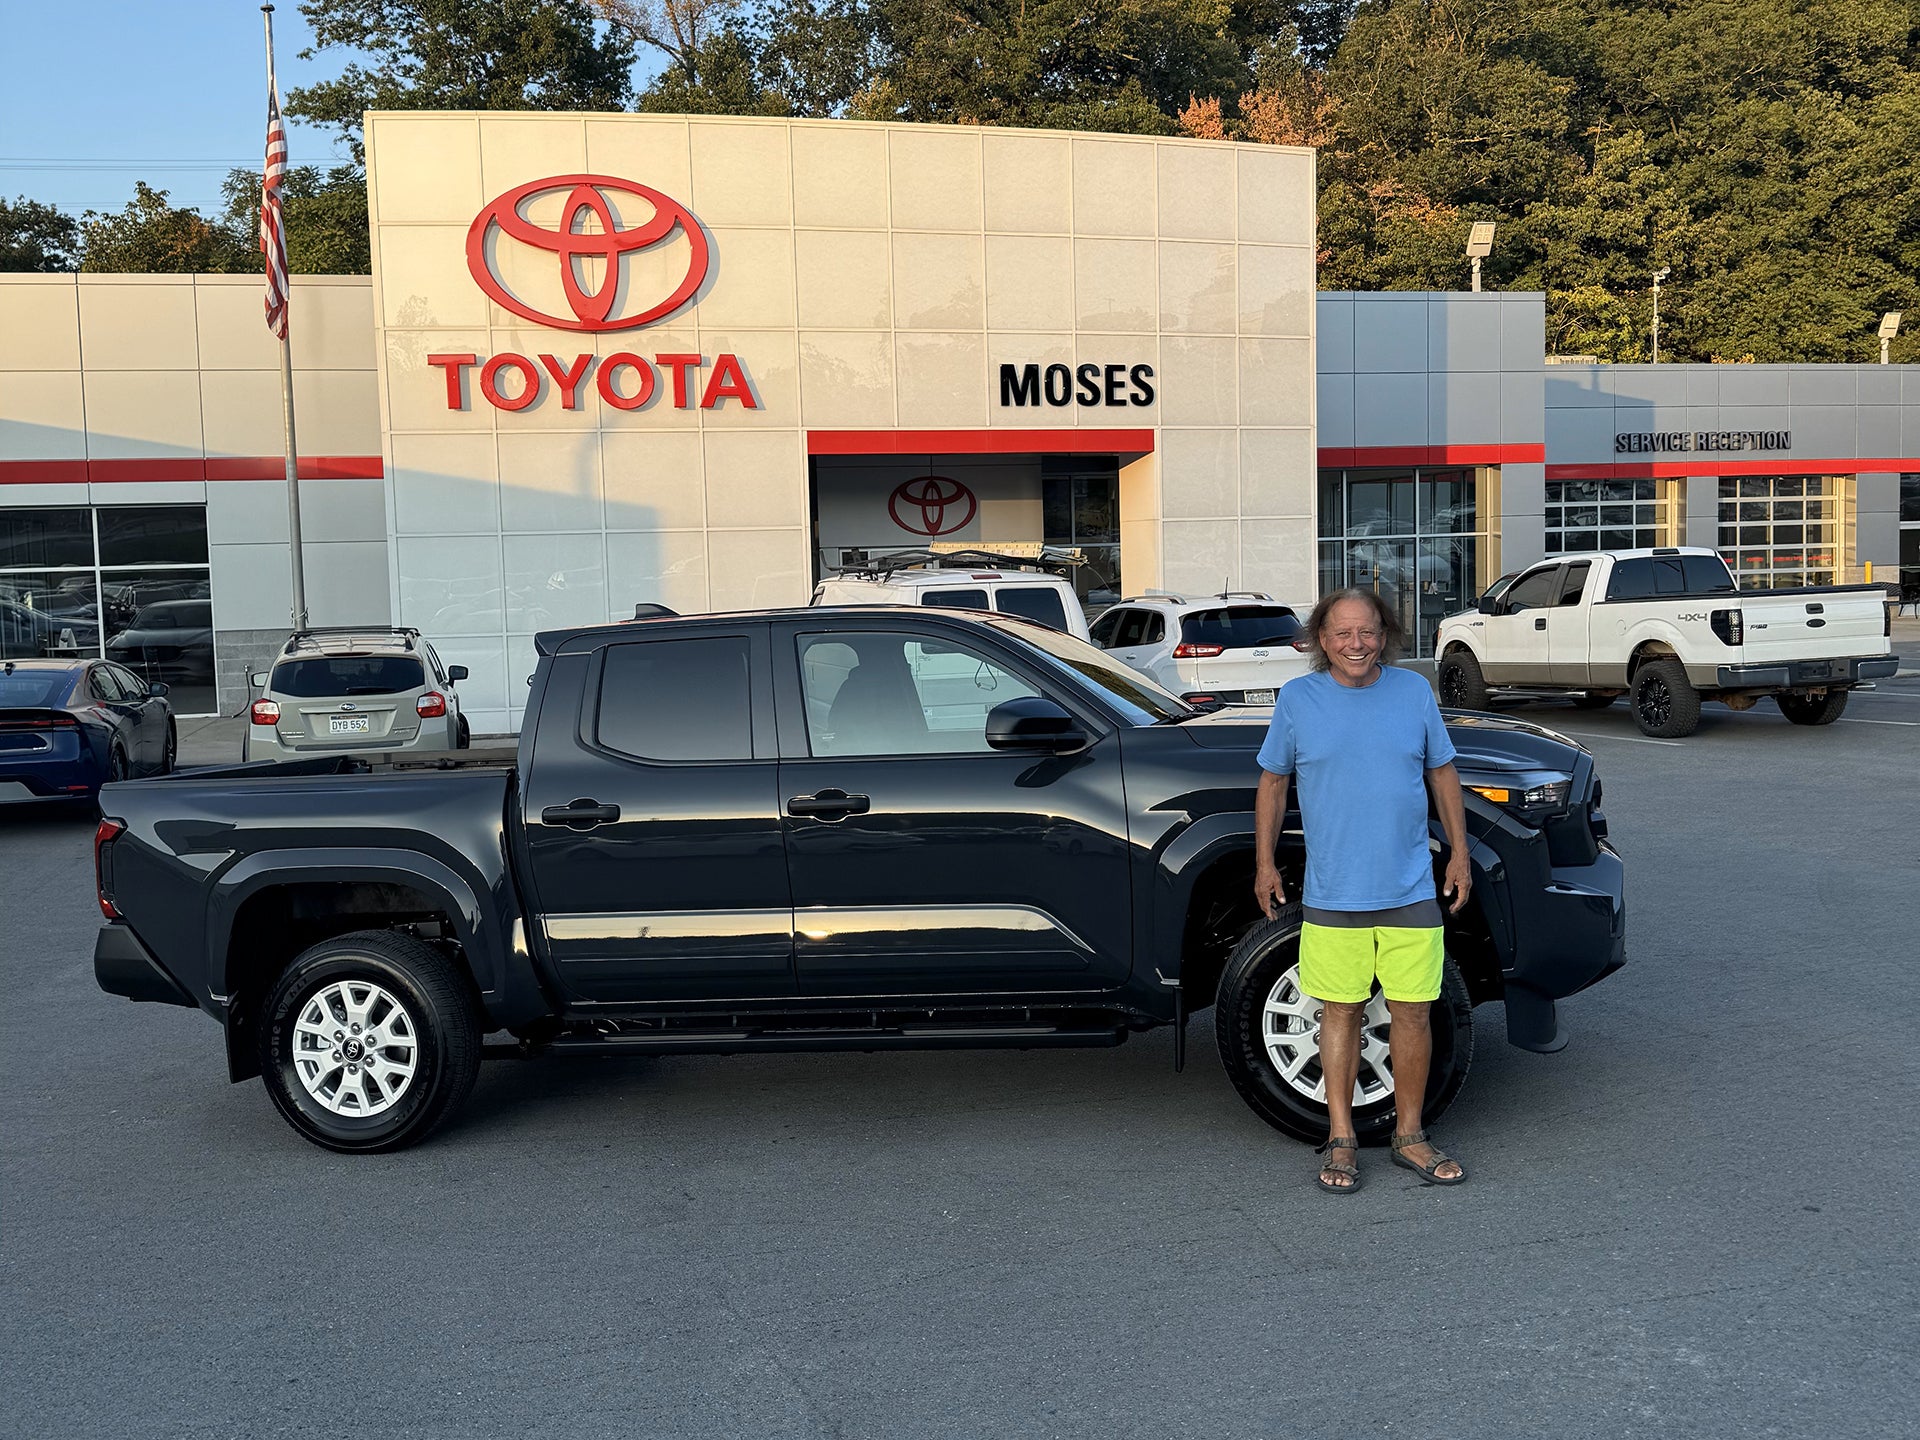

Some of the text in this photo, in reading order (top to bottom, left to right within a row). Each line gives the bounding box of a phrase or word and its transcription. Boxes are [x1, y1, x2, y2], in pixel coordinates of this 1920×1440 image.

[427, 352, 757, 411] TOYOTA
[1000, 363, 1155, 407] MOSES
[1616, 431, 1791, 453] SERVICE RECEPTION
